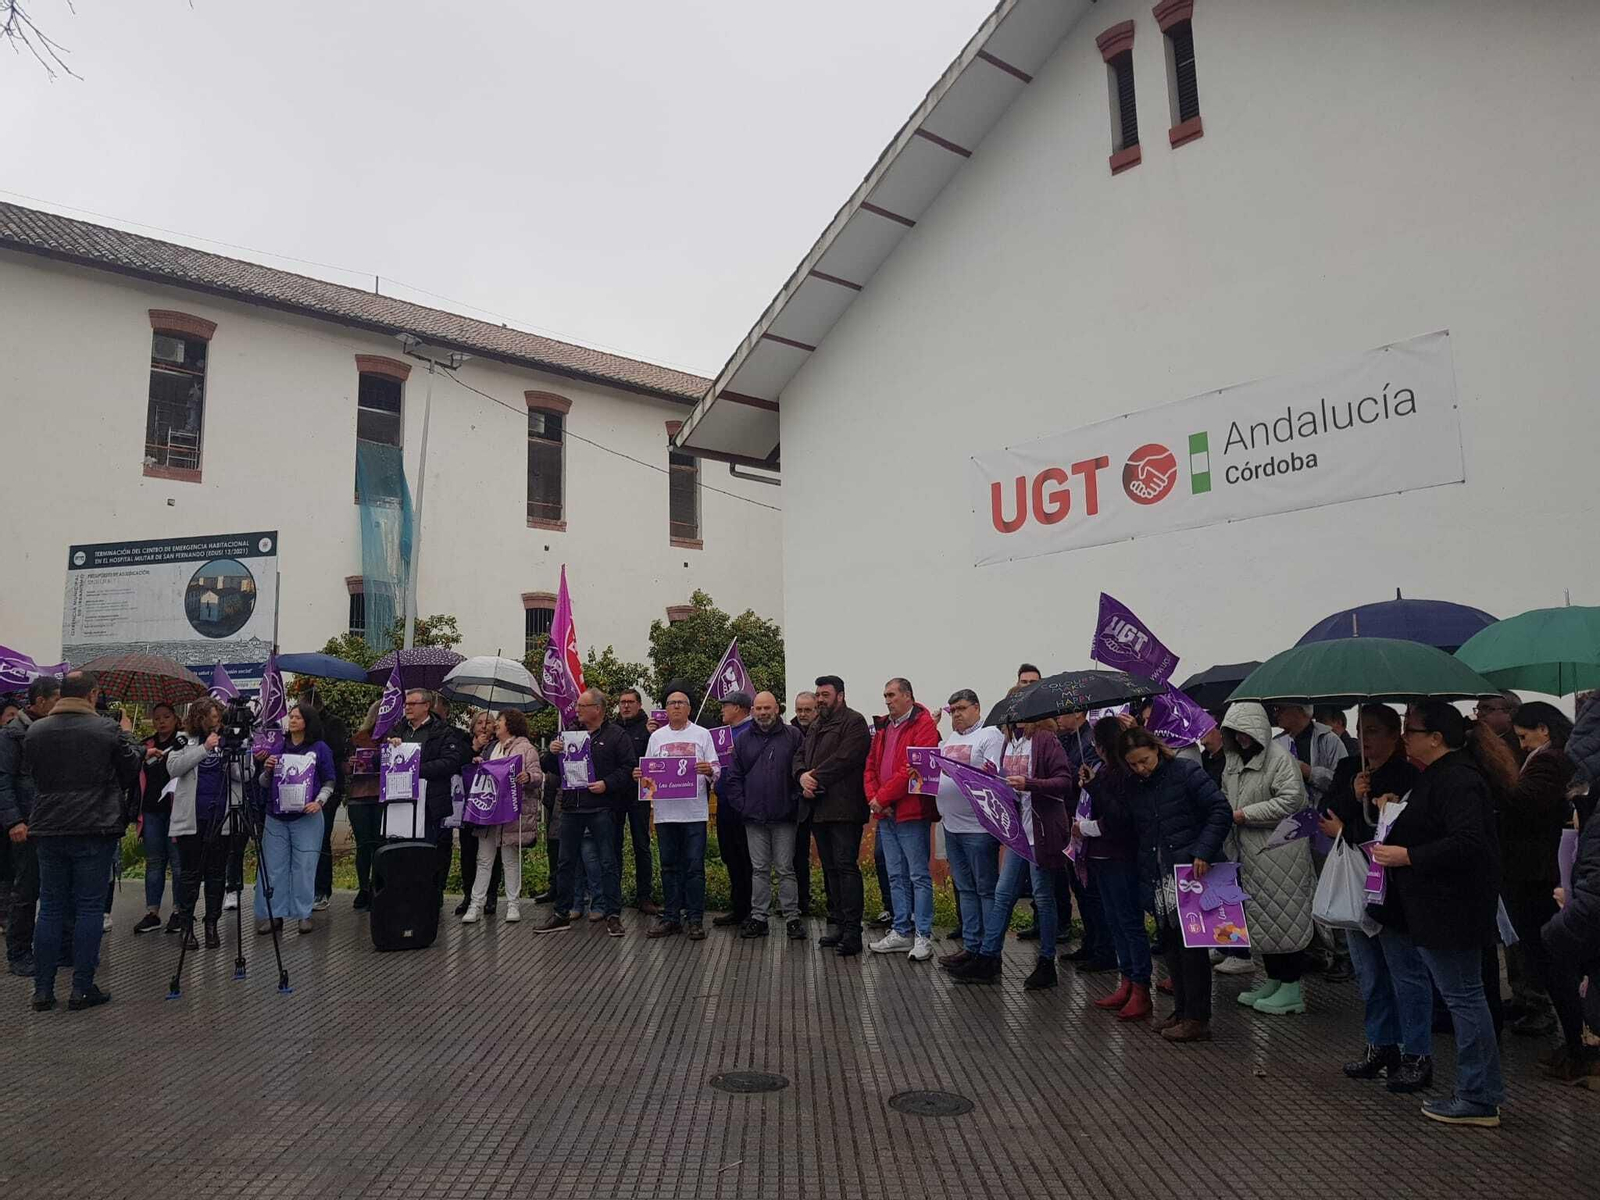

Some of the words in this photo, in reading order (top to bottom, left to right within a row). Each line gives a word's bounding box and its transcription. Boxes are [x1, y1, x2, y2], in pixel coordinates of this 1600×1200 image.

[1223, 383, 1418, 455] Andalucía
[1225, 451, 1319, 485] Córdoba
[990, 455, 1110, 534] UGT
[94, 549, 131, 557] TERMINACIÓN
[172, 544, 207, 552] EMERGENCIA
[208, 541, 249, 549] HABITACIONAL
[1110, 616, 1149, 651] UGT
[1055, 694, 1092, 708] HAPPY
[1061, 690, 1080, 699] ME
[677, 758, 688, 776] 8
